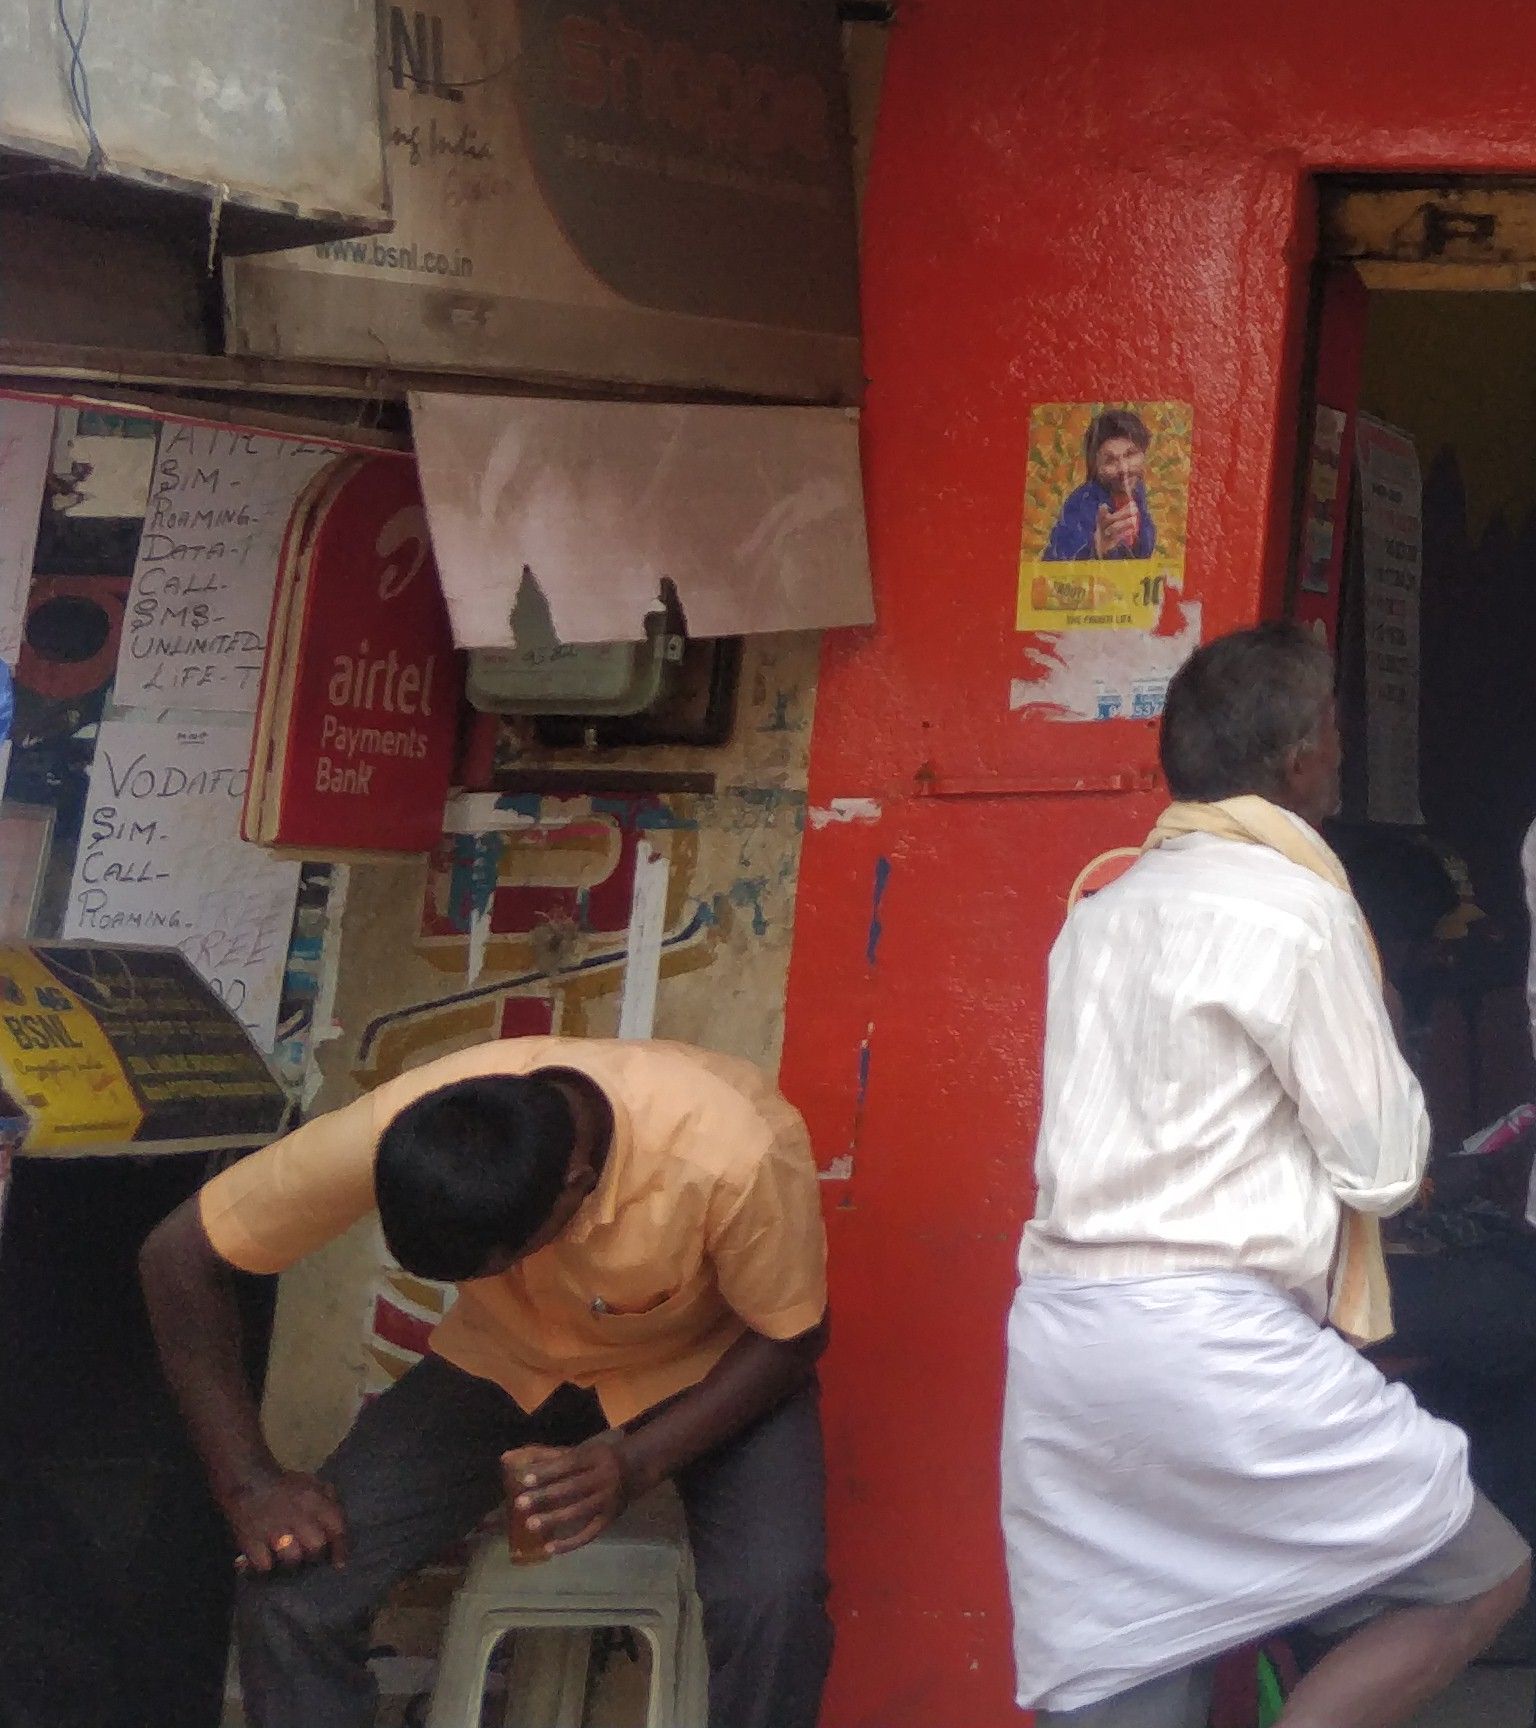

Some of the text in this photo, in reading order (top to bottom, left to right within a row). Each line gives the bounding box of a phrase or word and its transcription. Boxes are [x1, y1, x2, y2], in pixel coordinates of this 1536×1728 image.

[390, 5, 464, 103] NL
[328, 638, 437, 716] airtel
[321, 714, 428, 759] Payments
[315, 756, 376, 794] Bank
